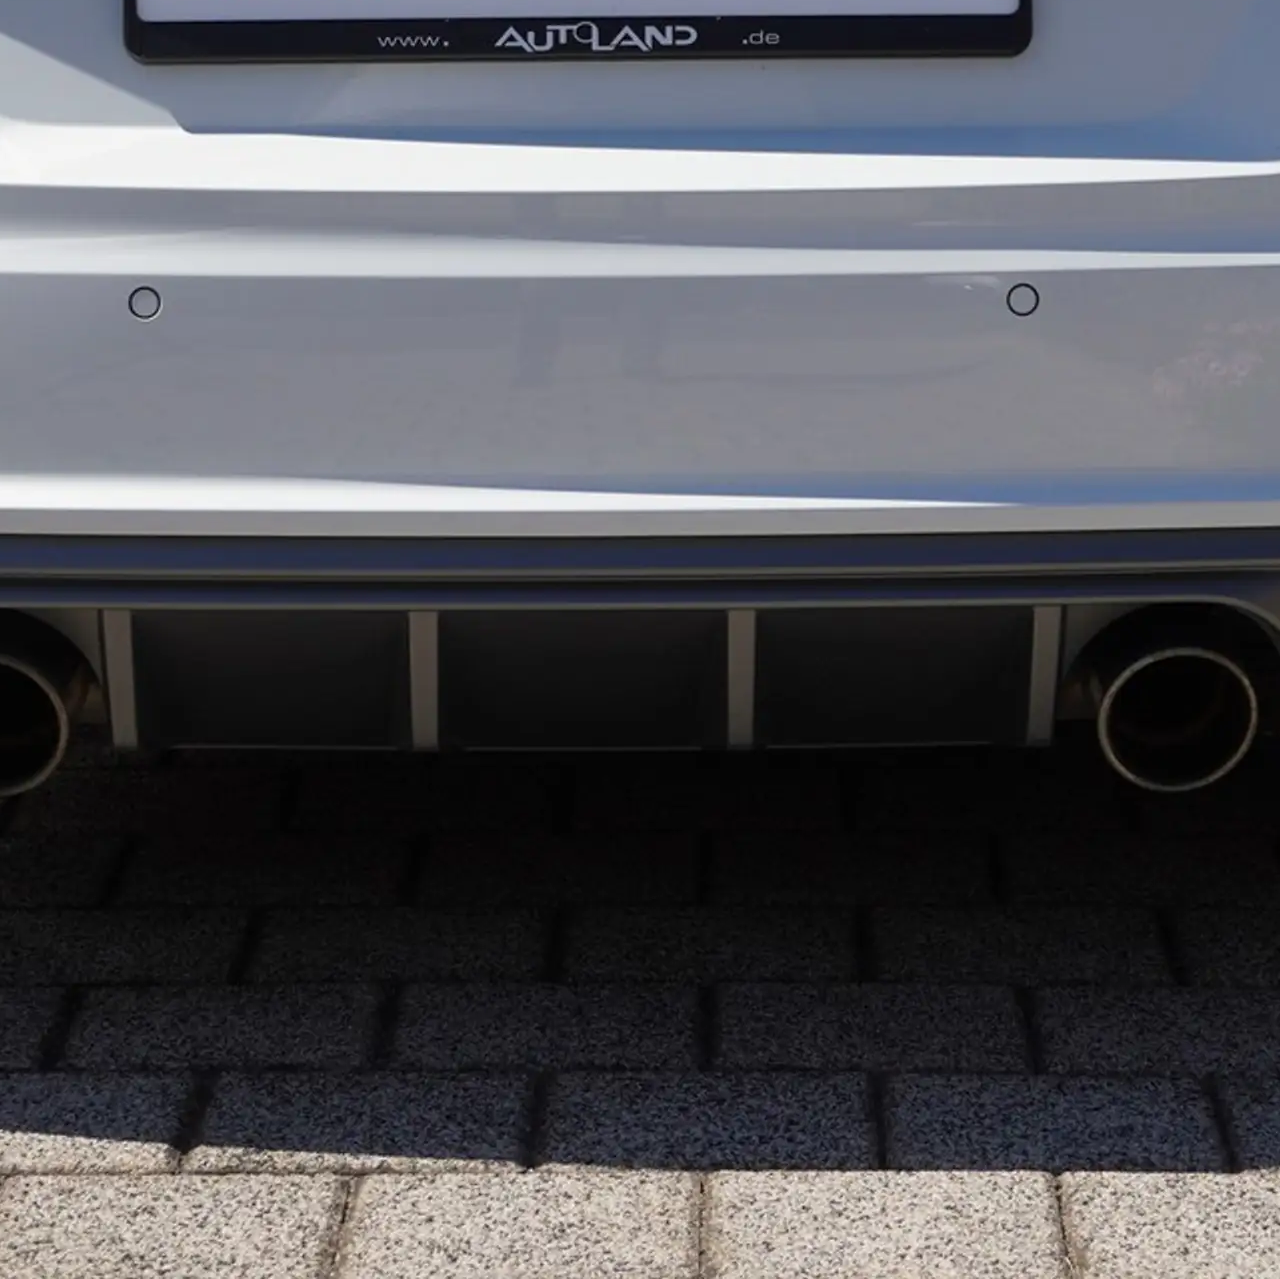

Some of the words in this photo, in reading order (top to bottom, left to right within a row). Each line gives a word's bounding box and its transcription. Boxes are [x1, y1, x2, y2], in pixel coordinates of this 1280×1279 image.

[377, 35, 450, 49] www.
[494, 21, 698, 53] AUTOLAND
[742, 29, 780, 45] .de
